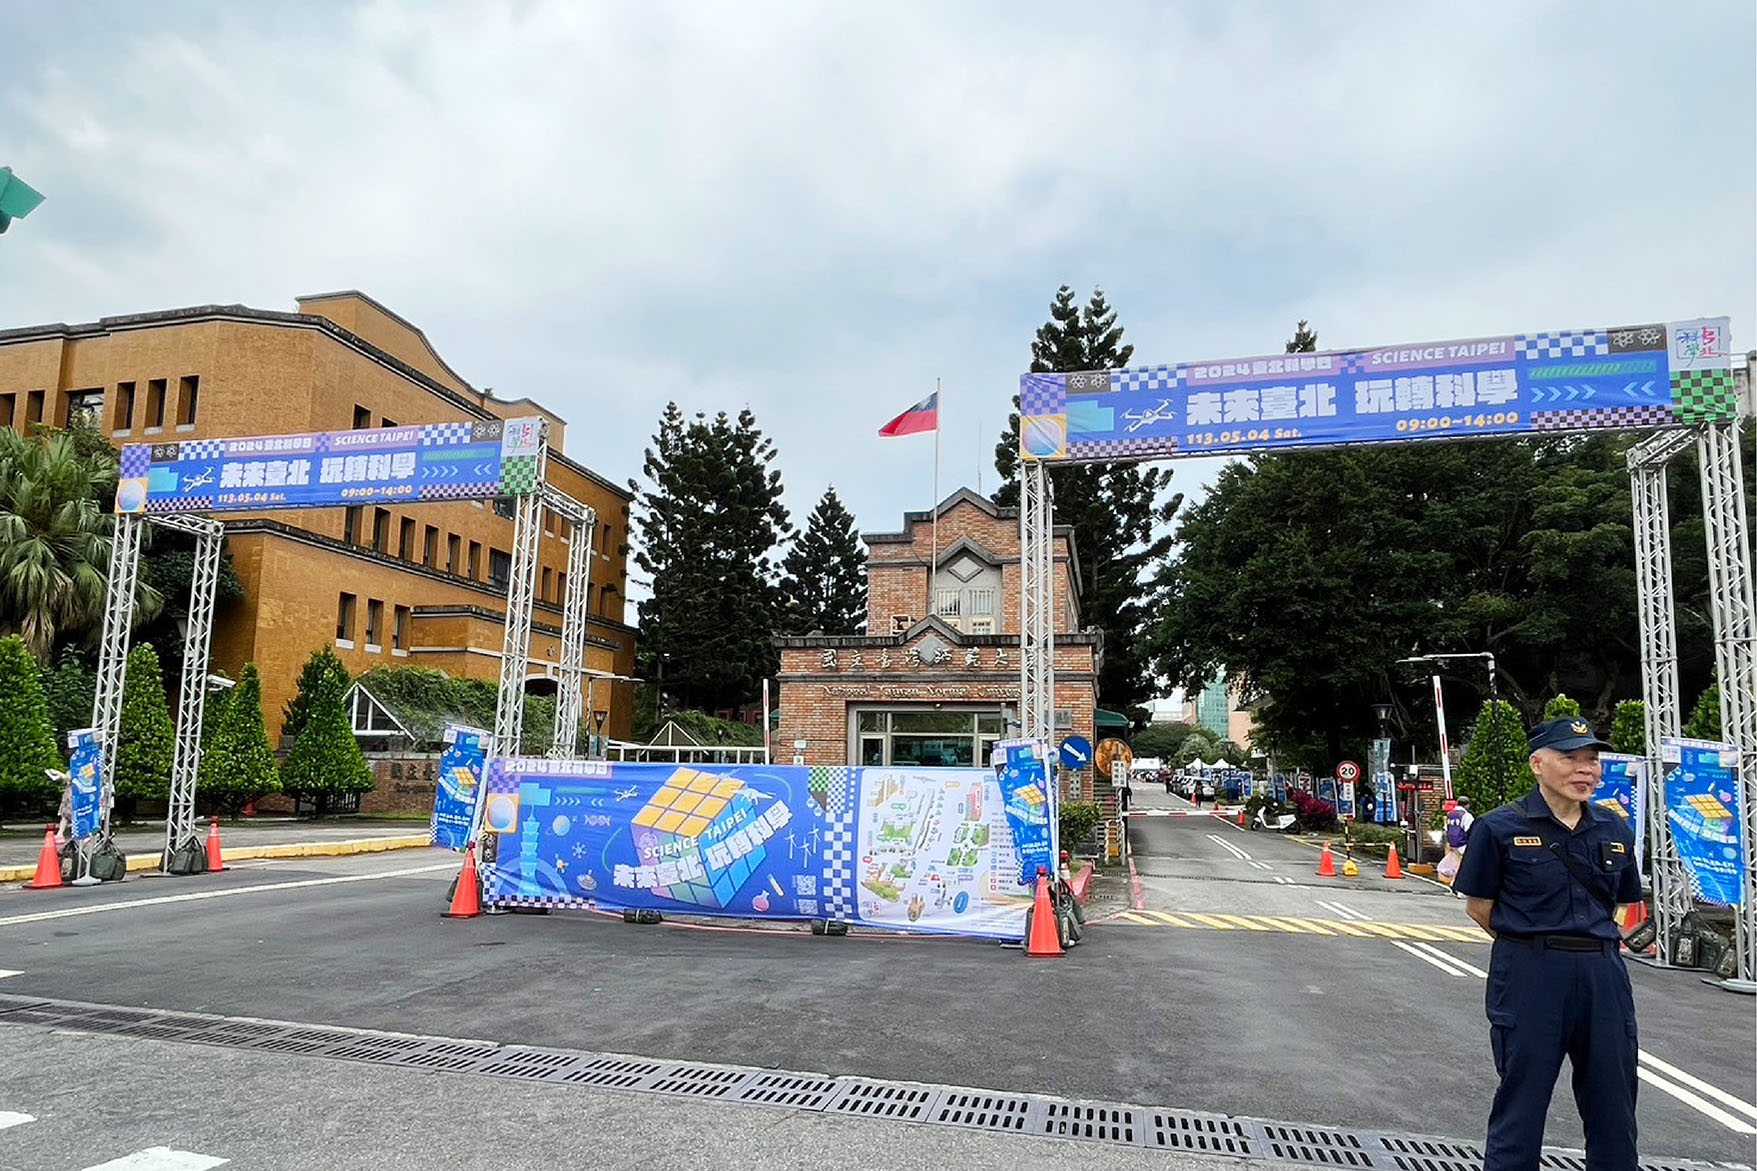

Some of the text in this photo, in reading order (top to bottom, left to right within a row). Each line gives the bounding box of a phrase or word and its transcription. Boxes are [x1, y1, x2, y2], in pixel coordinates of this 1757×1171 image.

[1372, 341, 1506, 365] SCIENCE TAIPEI
[1186, 382, 1337, 426] 未來臺北
[334, 430, 414, 446] SCIENCE TAIPEI
[1186, 427, 1302, 445] 113.05.04 Sat.
[219, 459, 311, 488] 未來臺北
[218, 492, 268, 503] 113.05.04
[1341, 767, 1355, 776] 20
[643, 807, 748, 859] SCIENCE TAIPEI
[613, 855, 703, 889] 未來臺北
